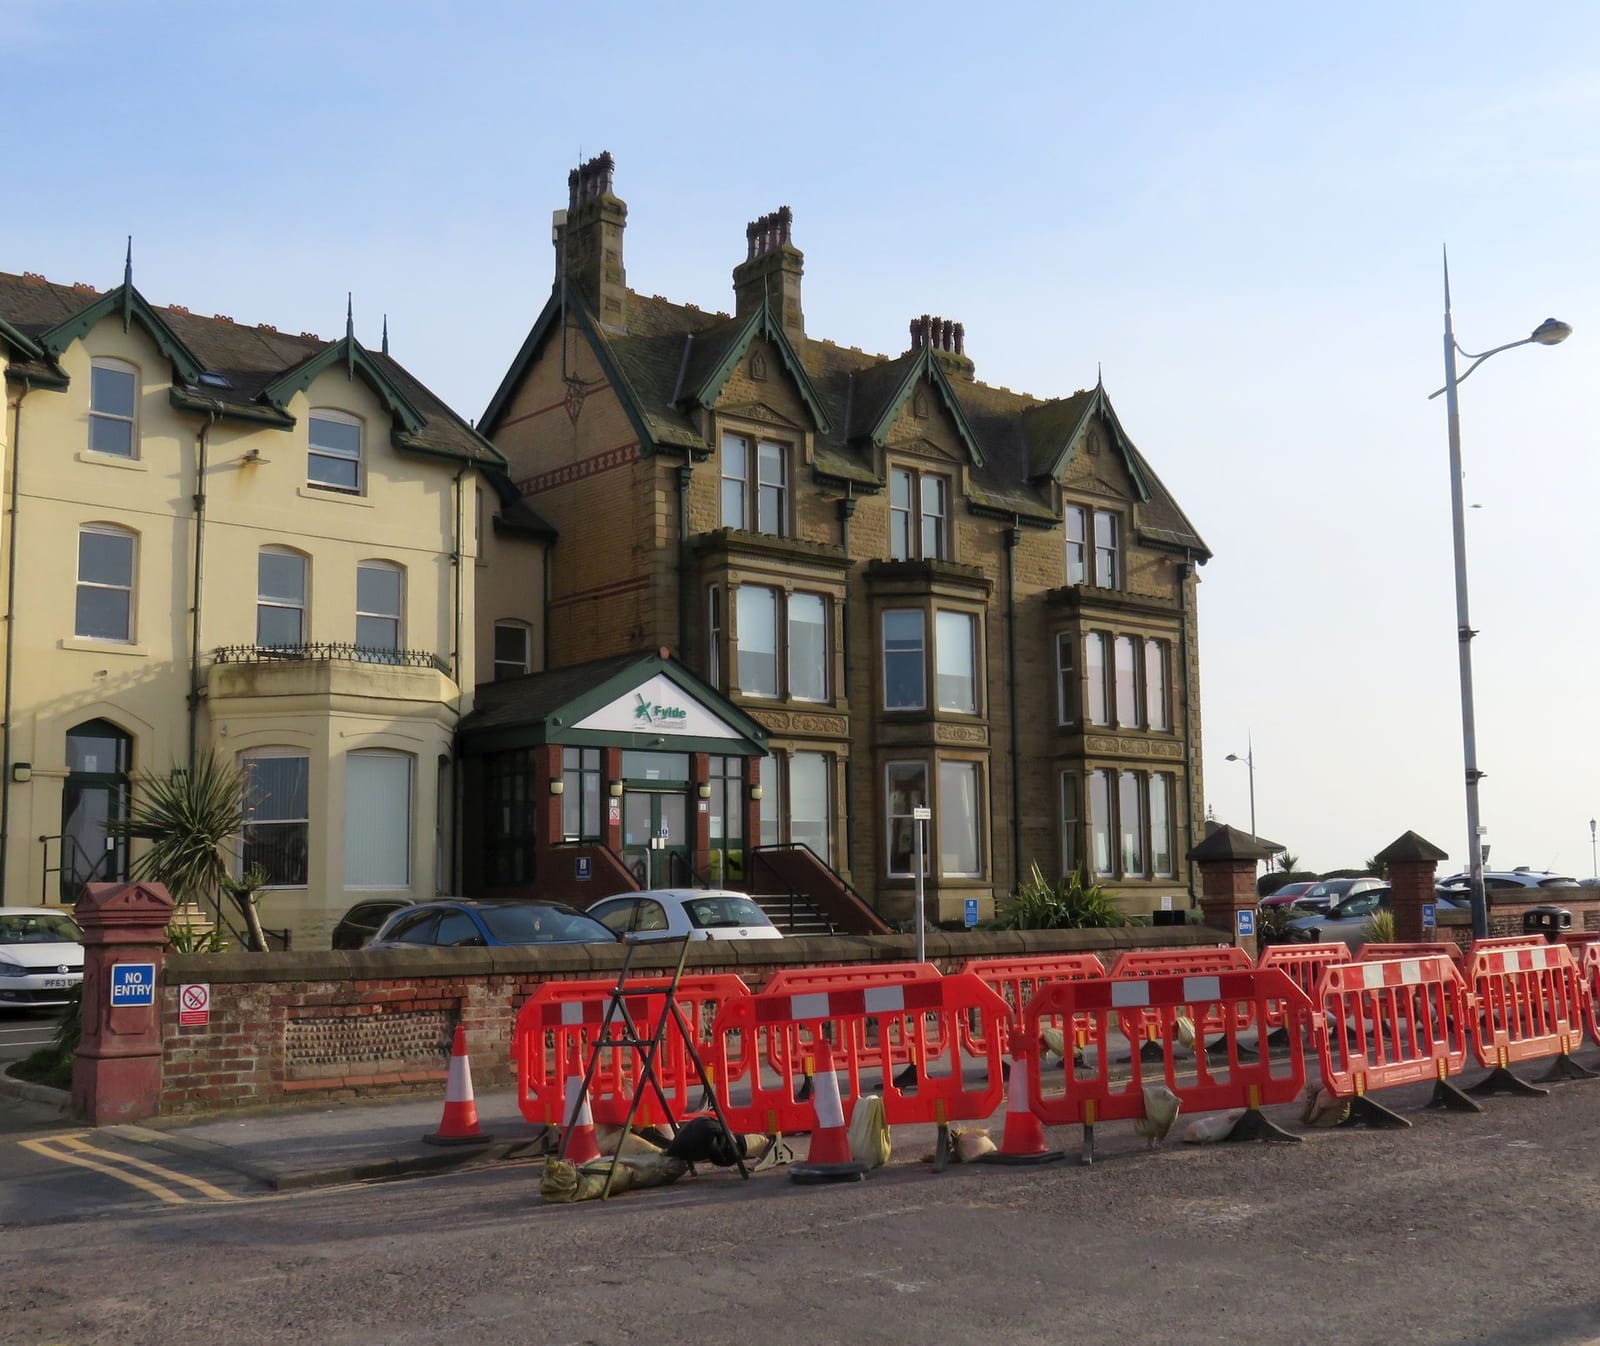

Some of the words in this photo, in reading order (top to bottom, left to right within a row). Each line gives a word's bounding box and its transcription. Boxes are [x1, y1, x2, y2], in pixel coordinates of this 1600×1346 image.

[654, 705, 686, 719] Fylde
[125, 972, 142, 983] NO
[114, 984, 152, 996] ENTRY
